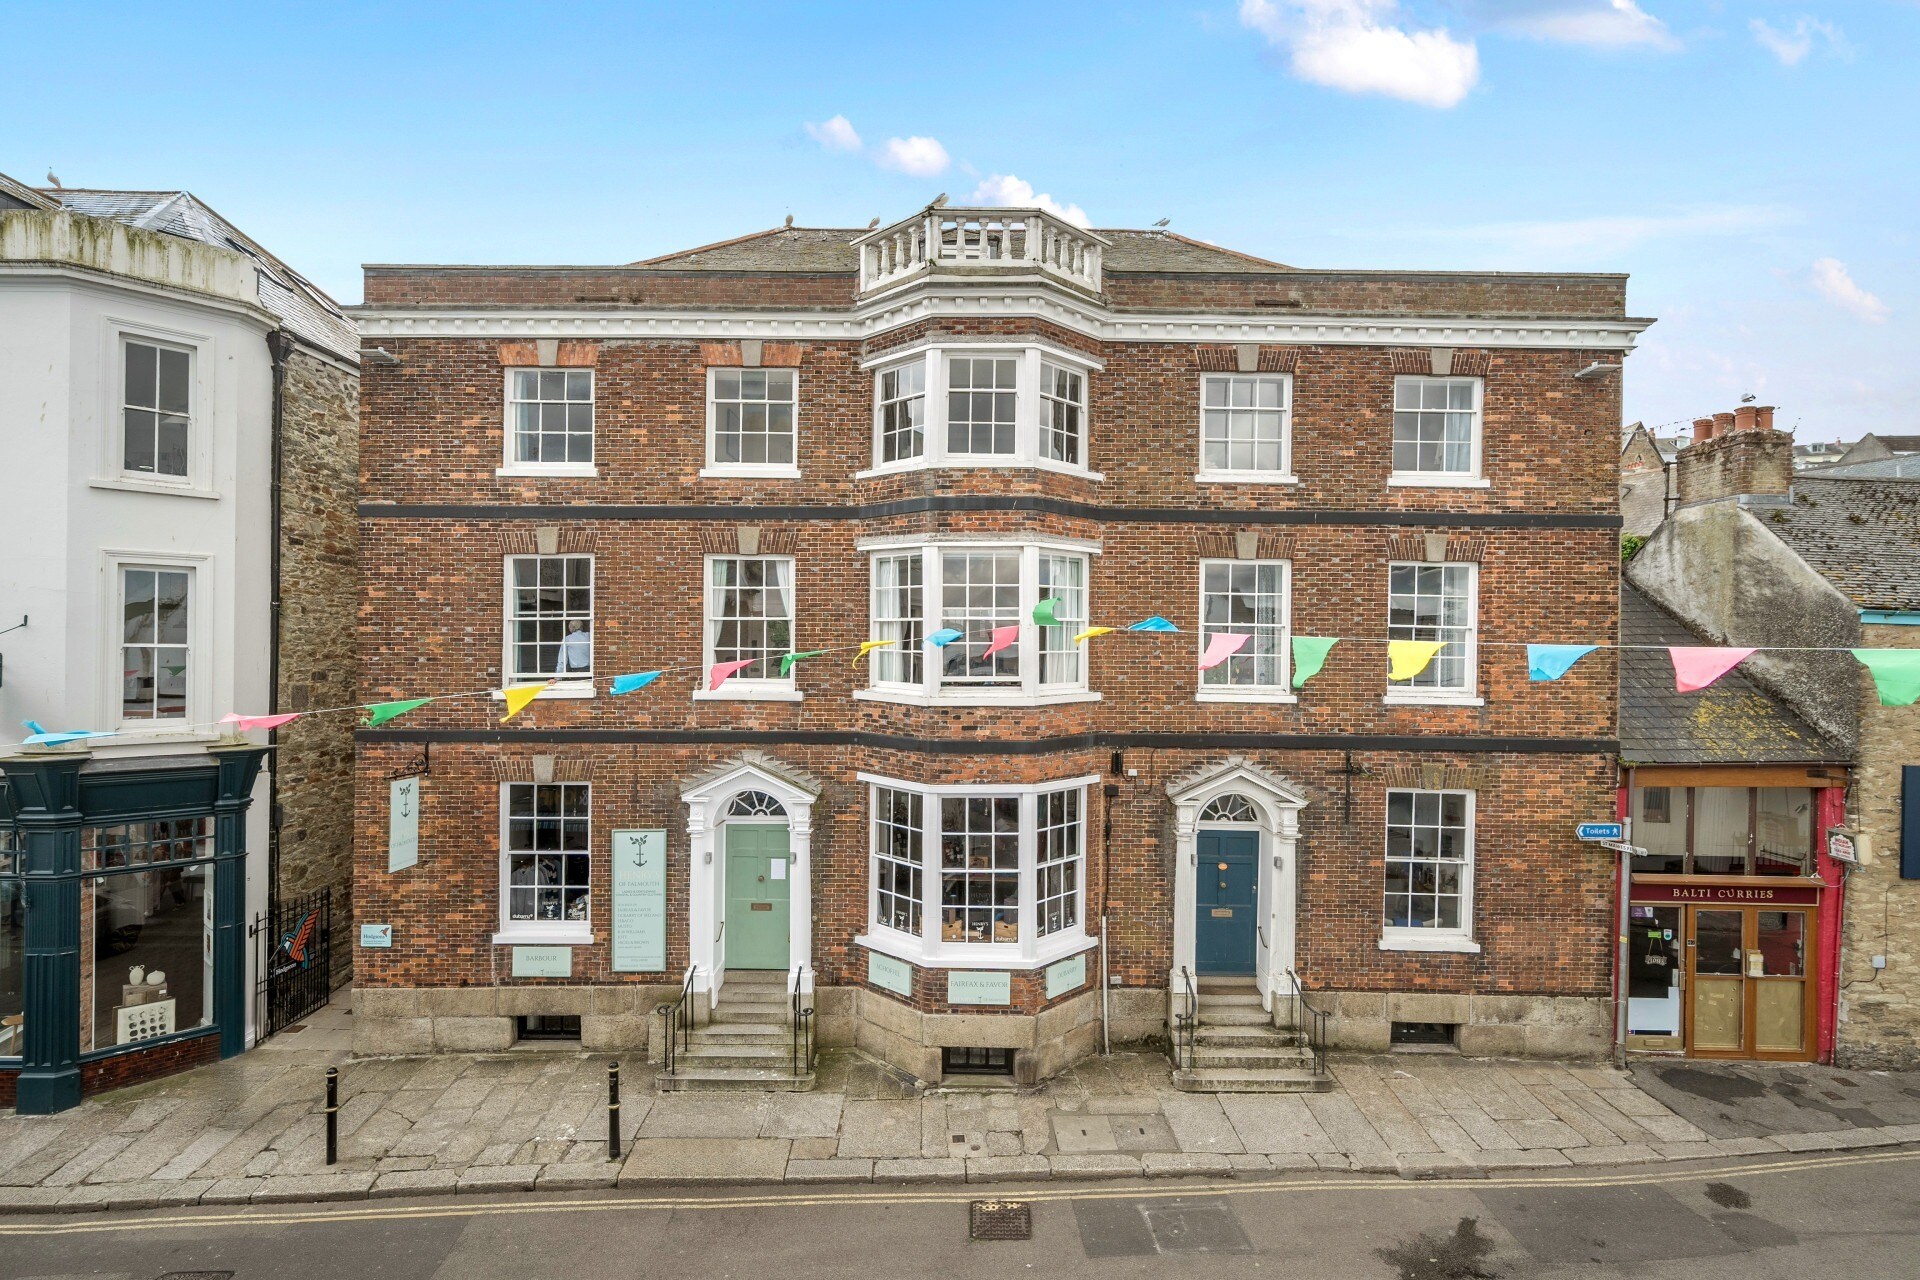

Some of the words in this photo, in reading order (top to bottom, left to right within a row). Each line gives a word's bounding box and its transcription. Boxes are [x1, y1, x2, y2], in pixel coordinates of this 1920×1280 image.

[1585, 827, 1610, 835] Toilets
[1672, 888, 1711, 897] BALTI
[1718, 889, 1774, 899] CURRIES
